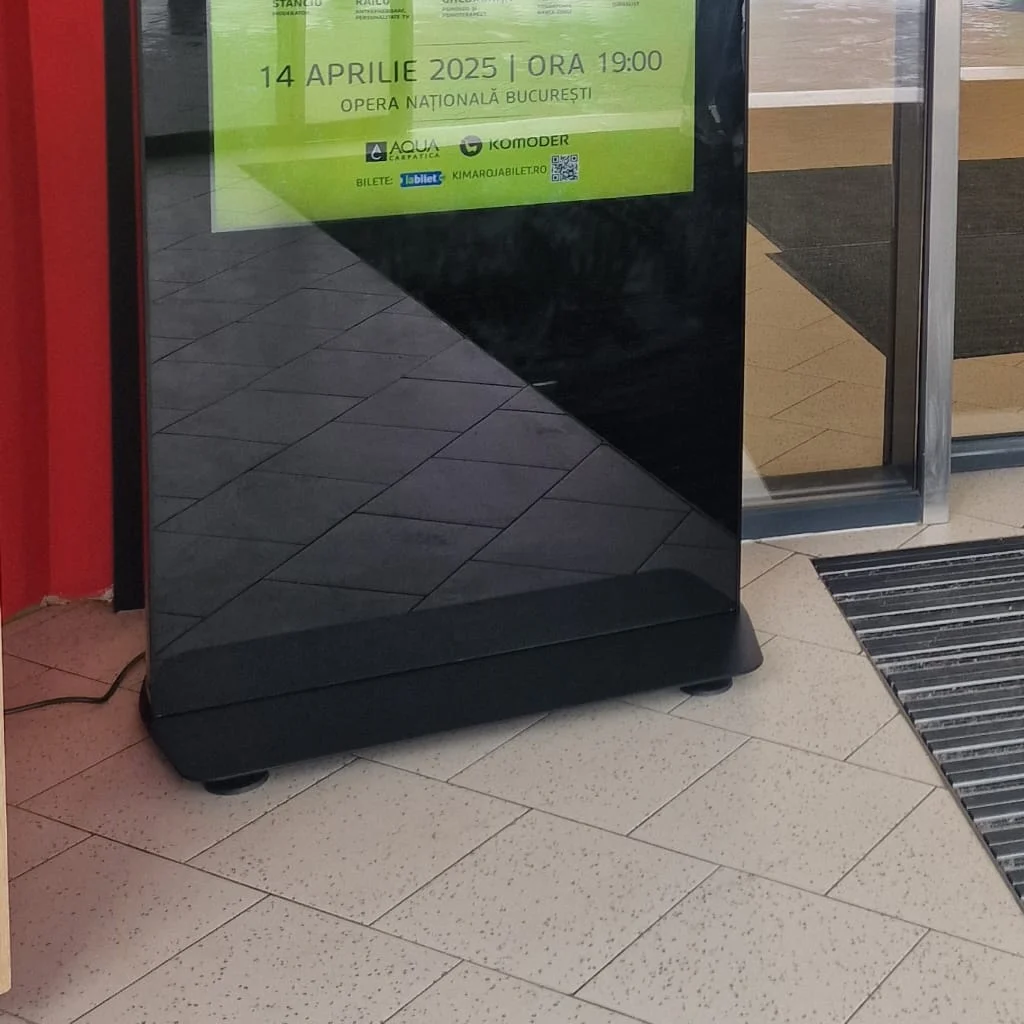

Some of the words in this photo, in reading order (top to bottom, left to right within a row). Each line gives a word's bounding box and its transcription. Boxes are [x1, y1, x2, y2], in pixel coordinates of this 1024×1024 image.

[260, 65, 295, 88] 14
[306, 60, 417, 87] APRILIE
[430, 57, 497, 81] 2025
[527, 53, 585, 76] ORA
[599, 50, 662, 73] 19:00
[341, 97, 399, 112] OPERA
[406, 88, 499, 112] NAȚIONALĂ
[506, 87, 592, 104] BUCUREȘTI
[389, 139, 440, 154] AQUA
[489, 135, 569, 150] KOMODER
[389, 152, 440, 161] CARPATICA
[356, 176, 393, 188] BILETE:
